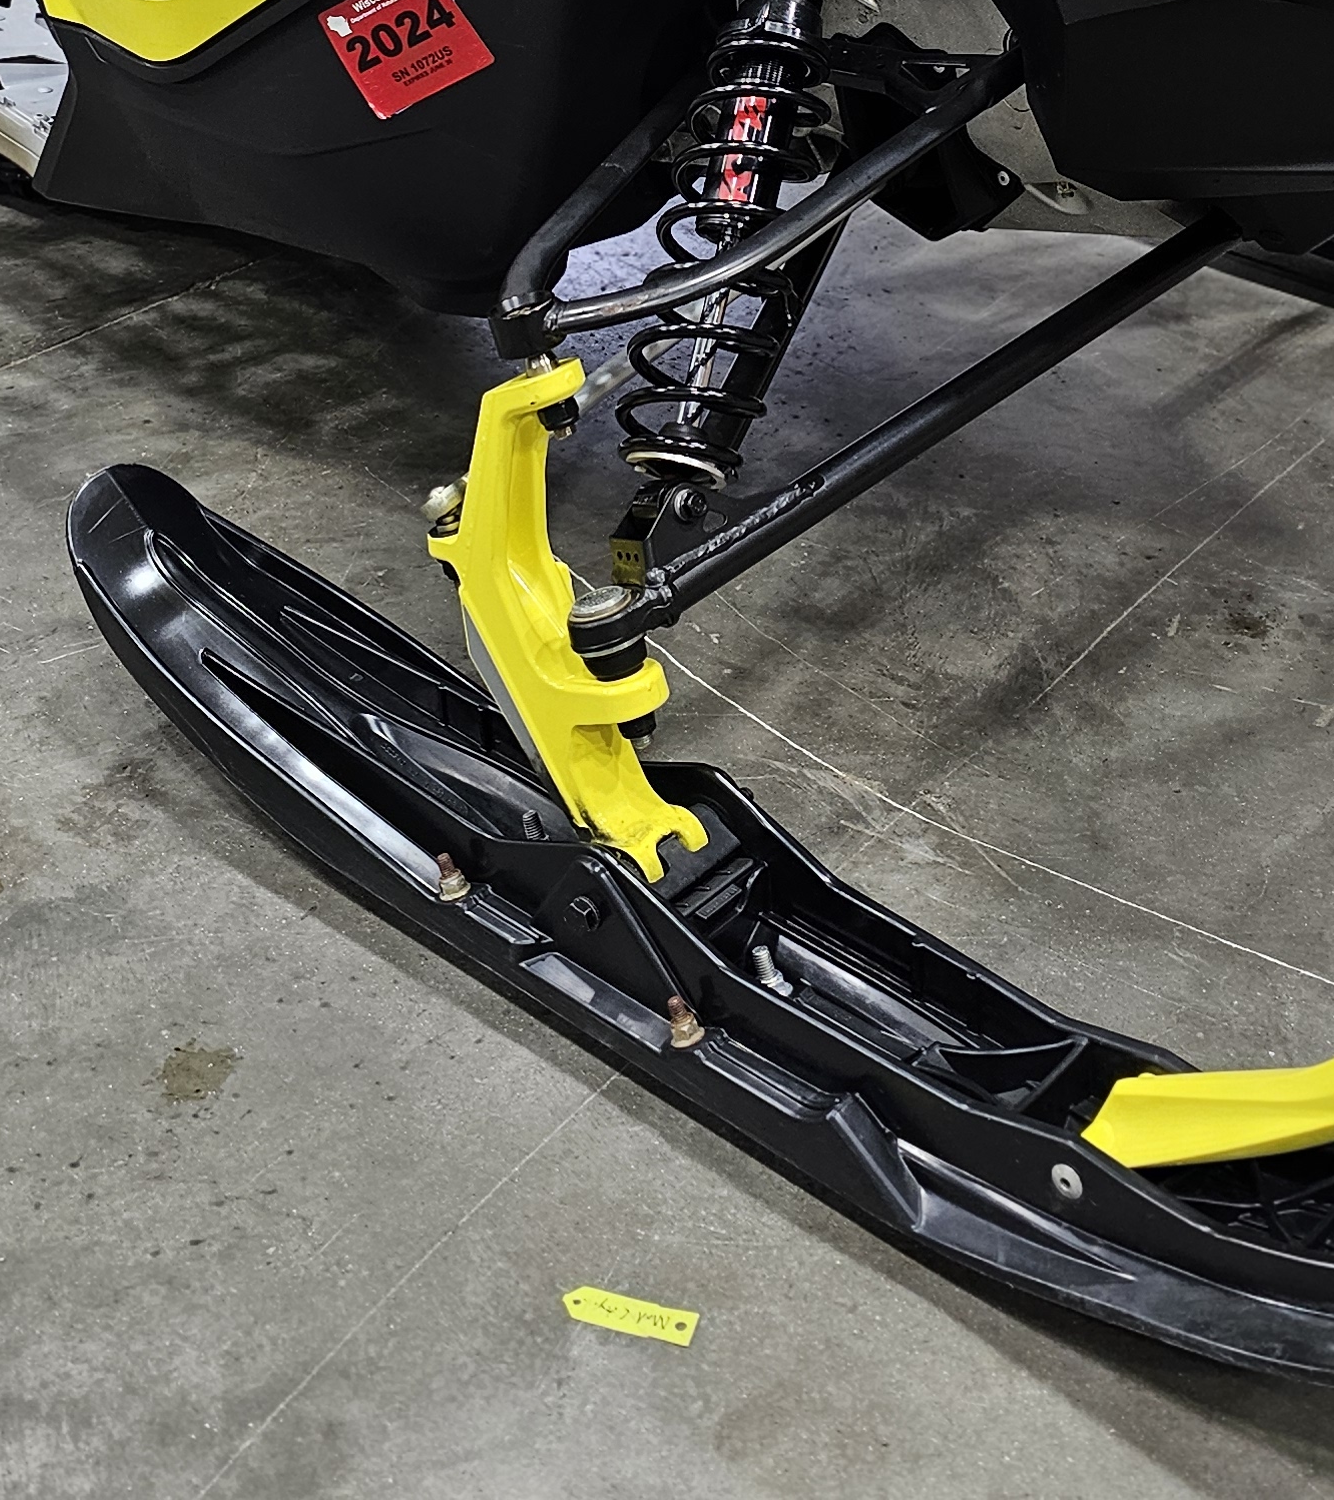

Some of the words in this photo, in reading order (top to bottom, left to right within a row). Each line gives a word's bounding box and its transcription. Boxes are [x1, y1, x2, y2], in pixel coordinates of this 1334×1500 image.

[350, 6, 378, 24] Department
[392, 67, 410, 82] SN
[410, 45, 453, 74] 1072US
